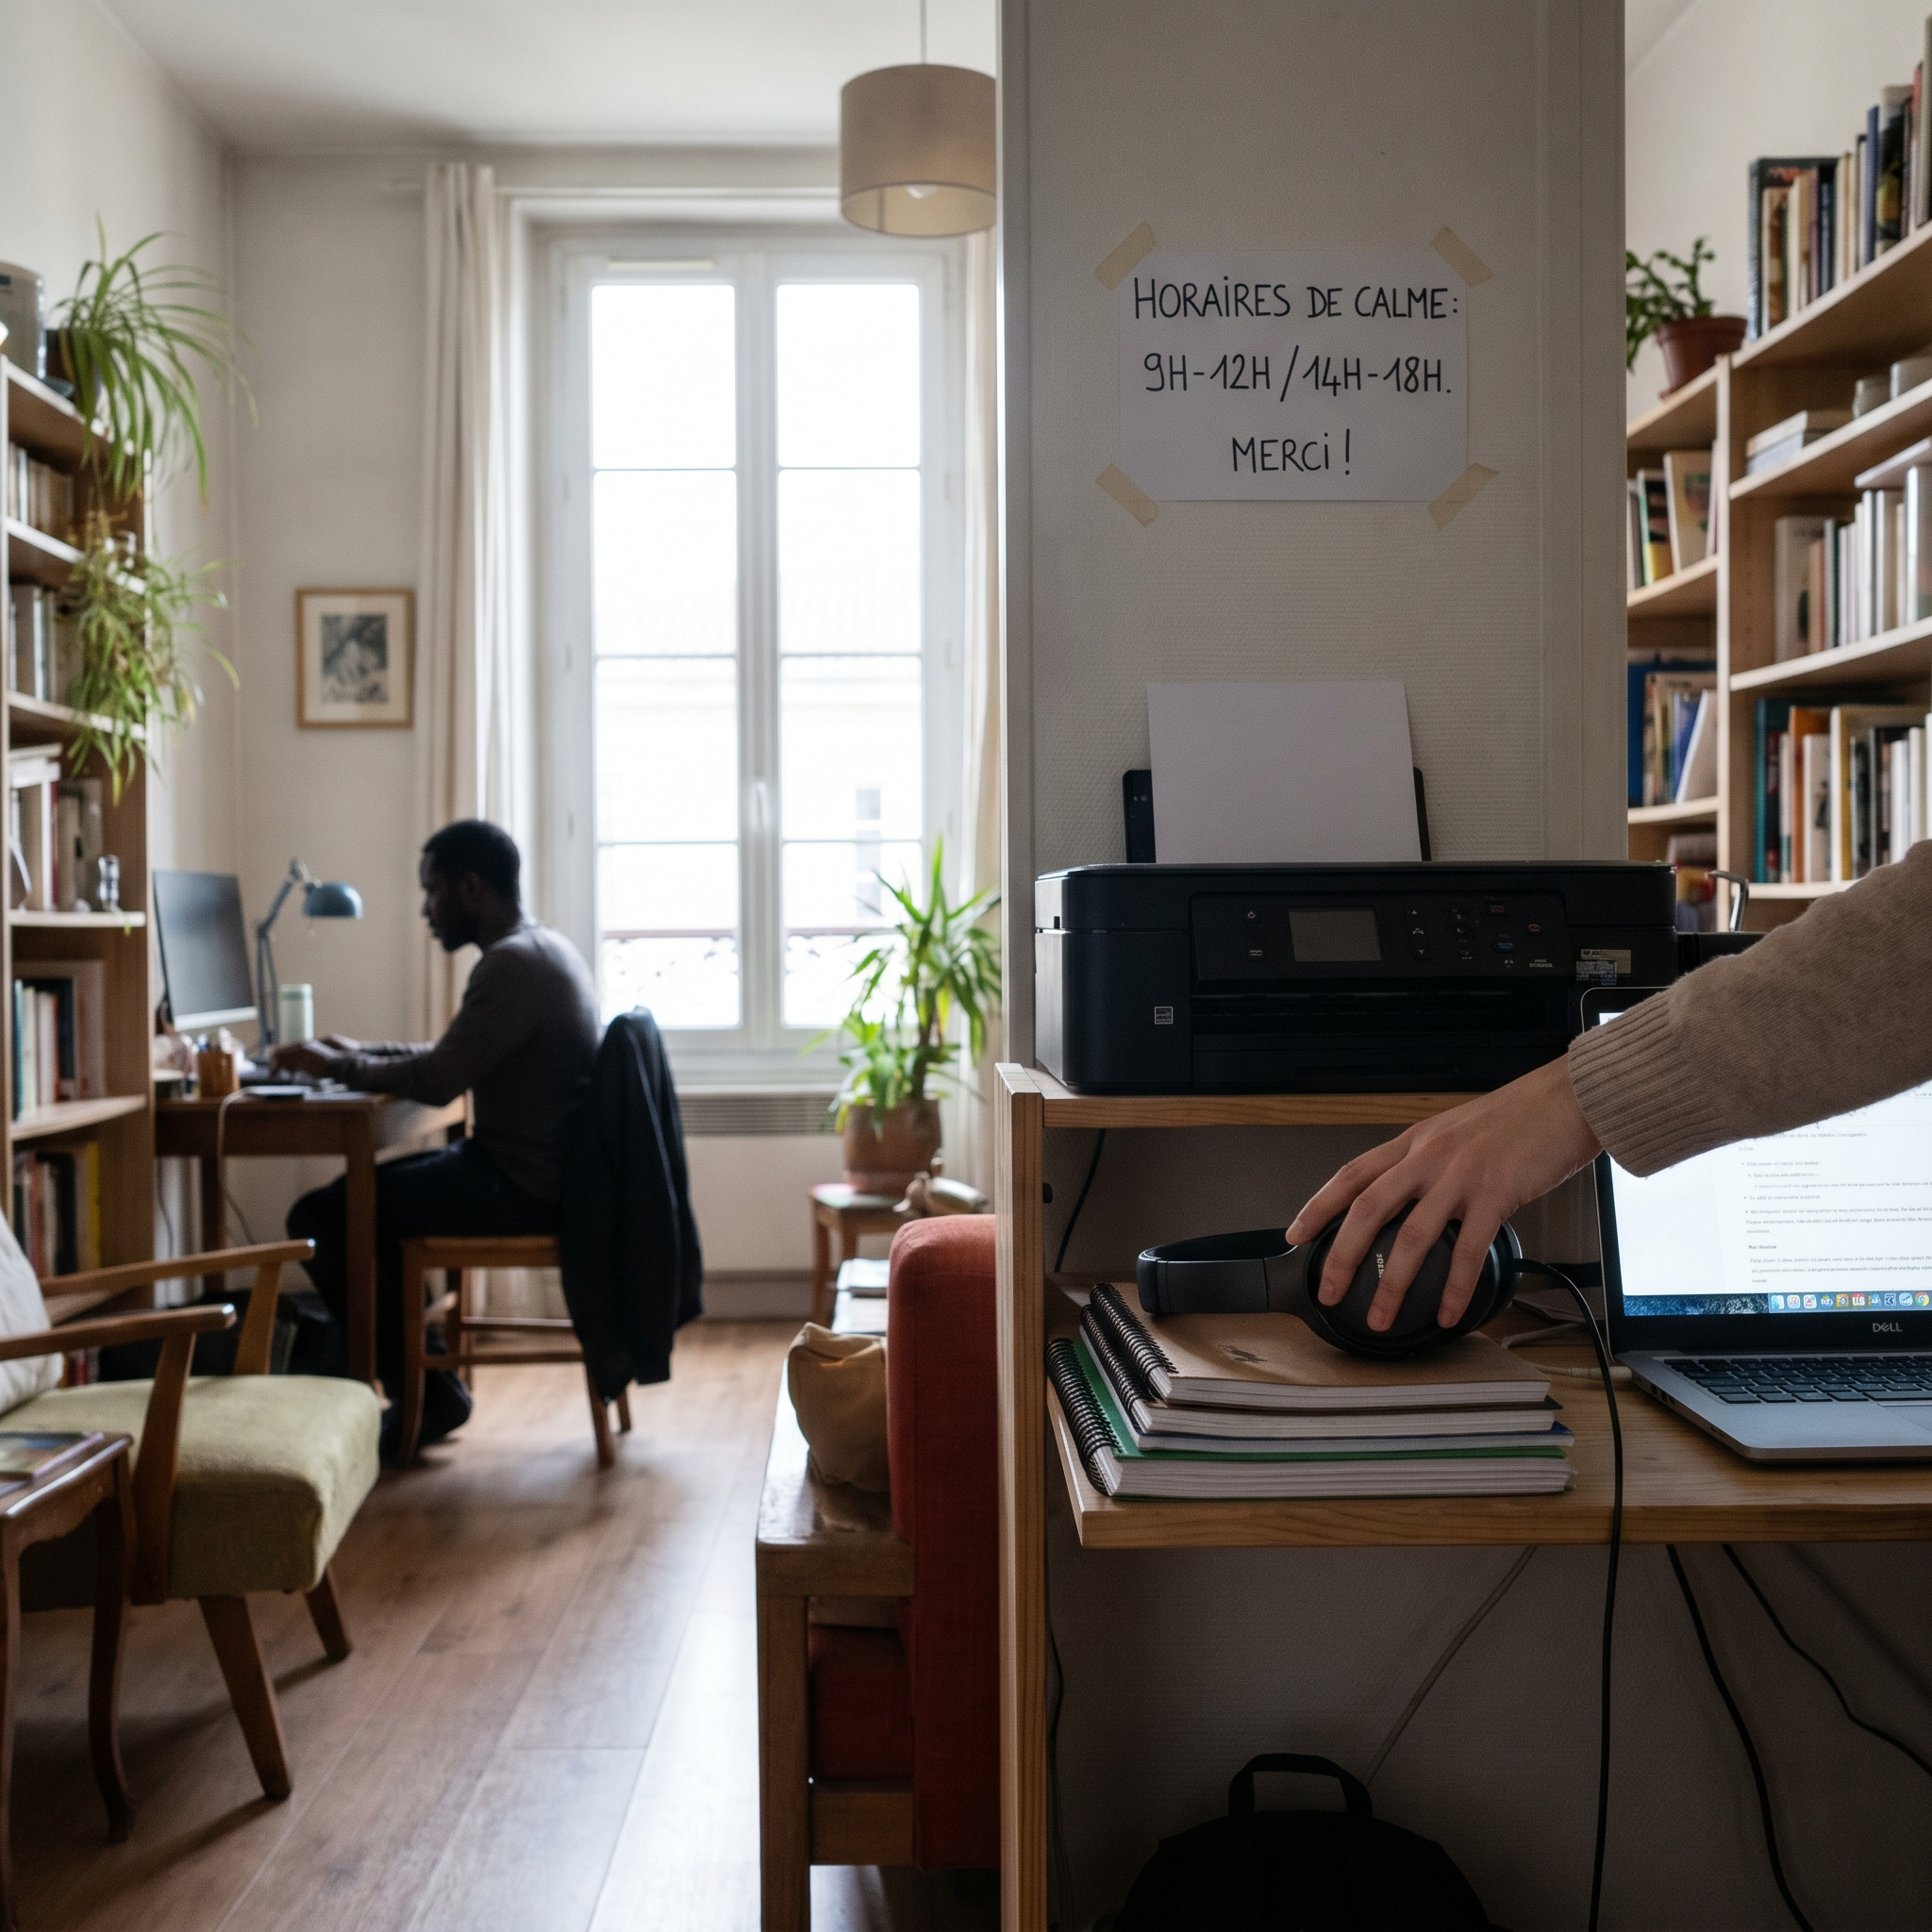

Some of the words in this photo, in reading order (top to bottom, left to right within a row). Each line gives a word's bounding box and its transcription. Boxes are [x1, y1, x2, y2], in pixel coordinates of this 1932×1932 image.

[1306, 286, 1343, 319] DE
[1354, 285, 1458, 320] CALME:
[1872, 1322, 1903, 1333] DELL
